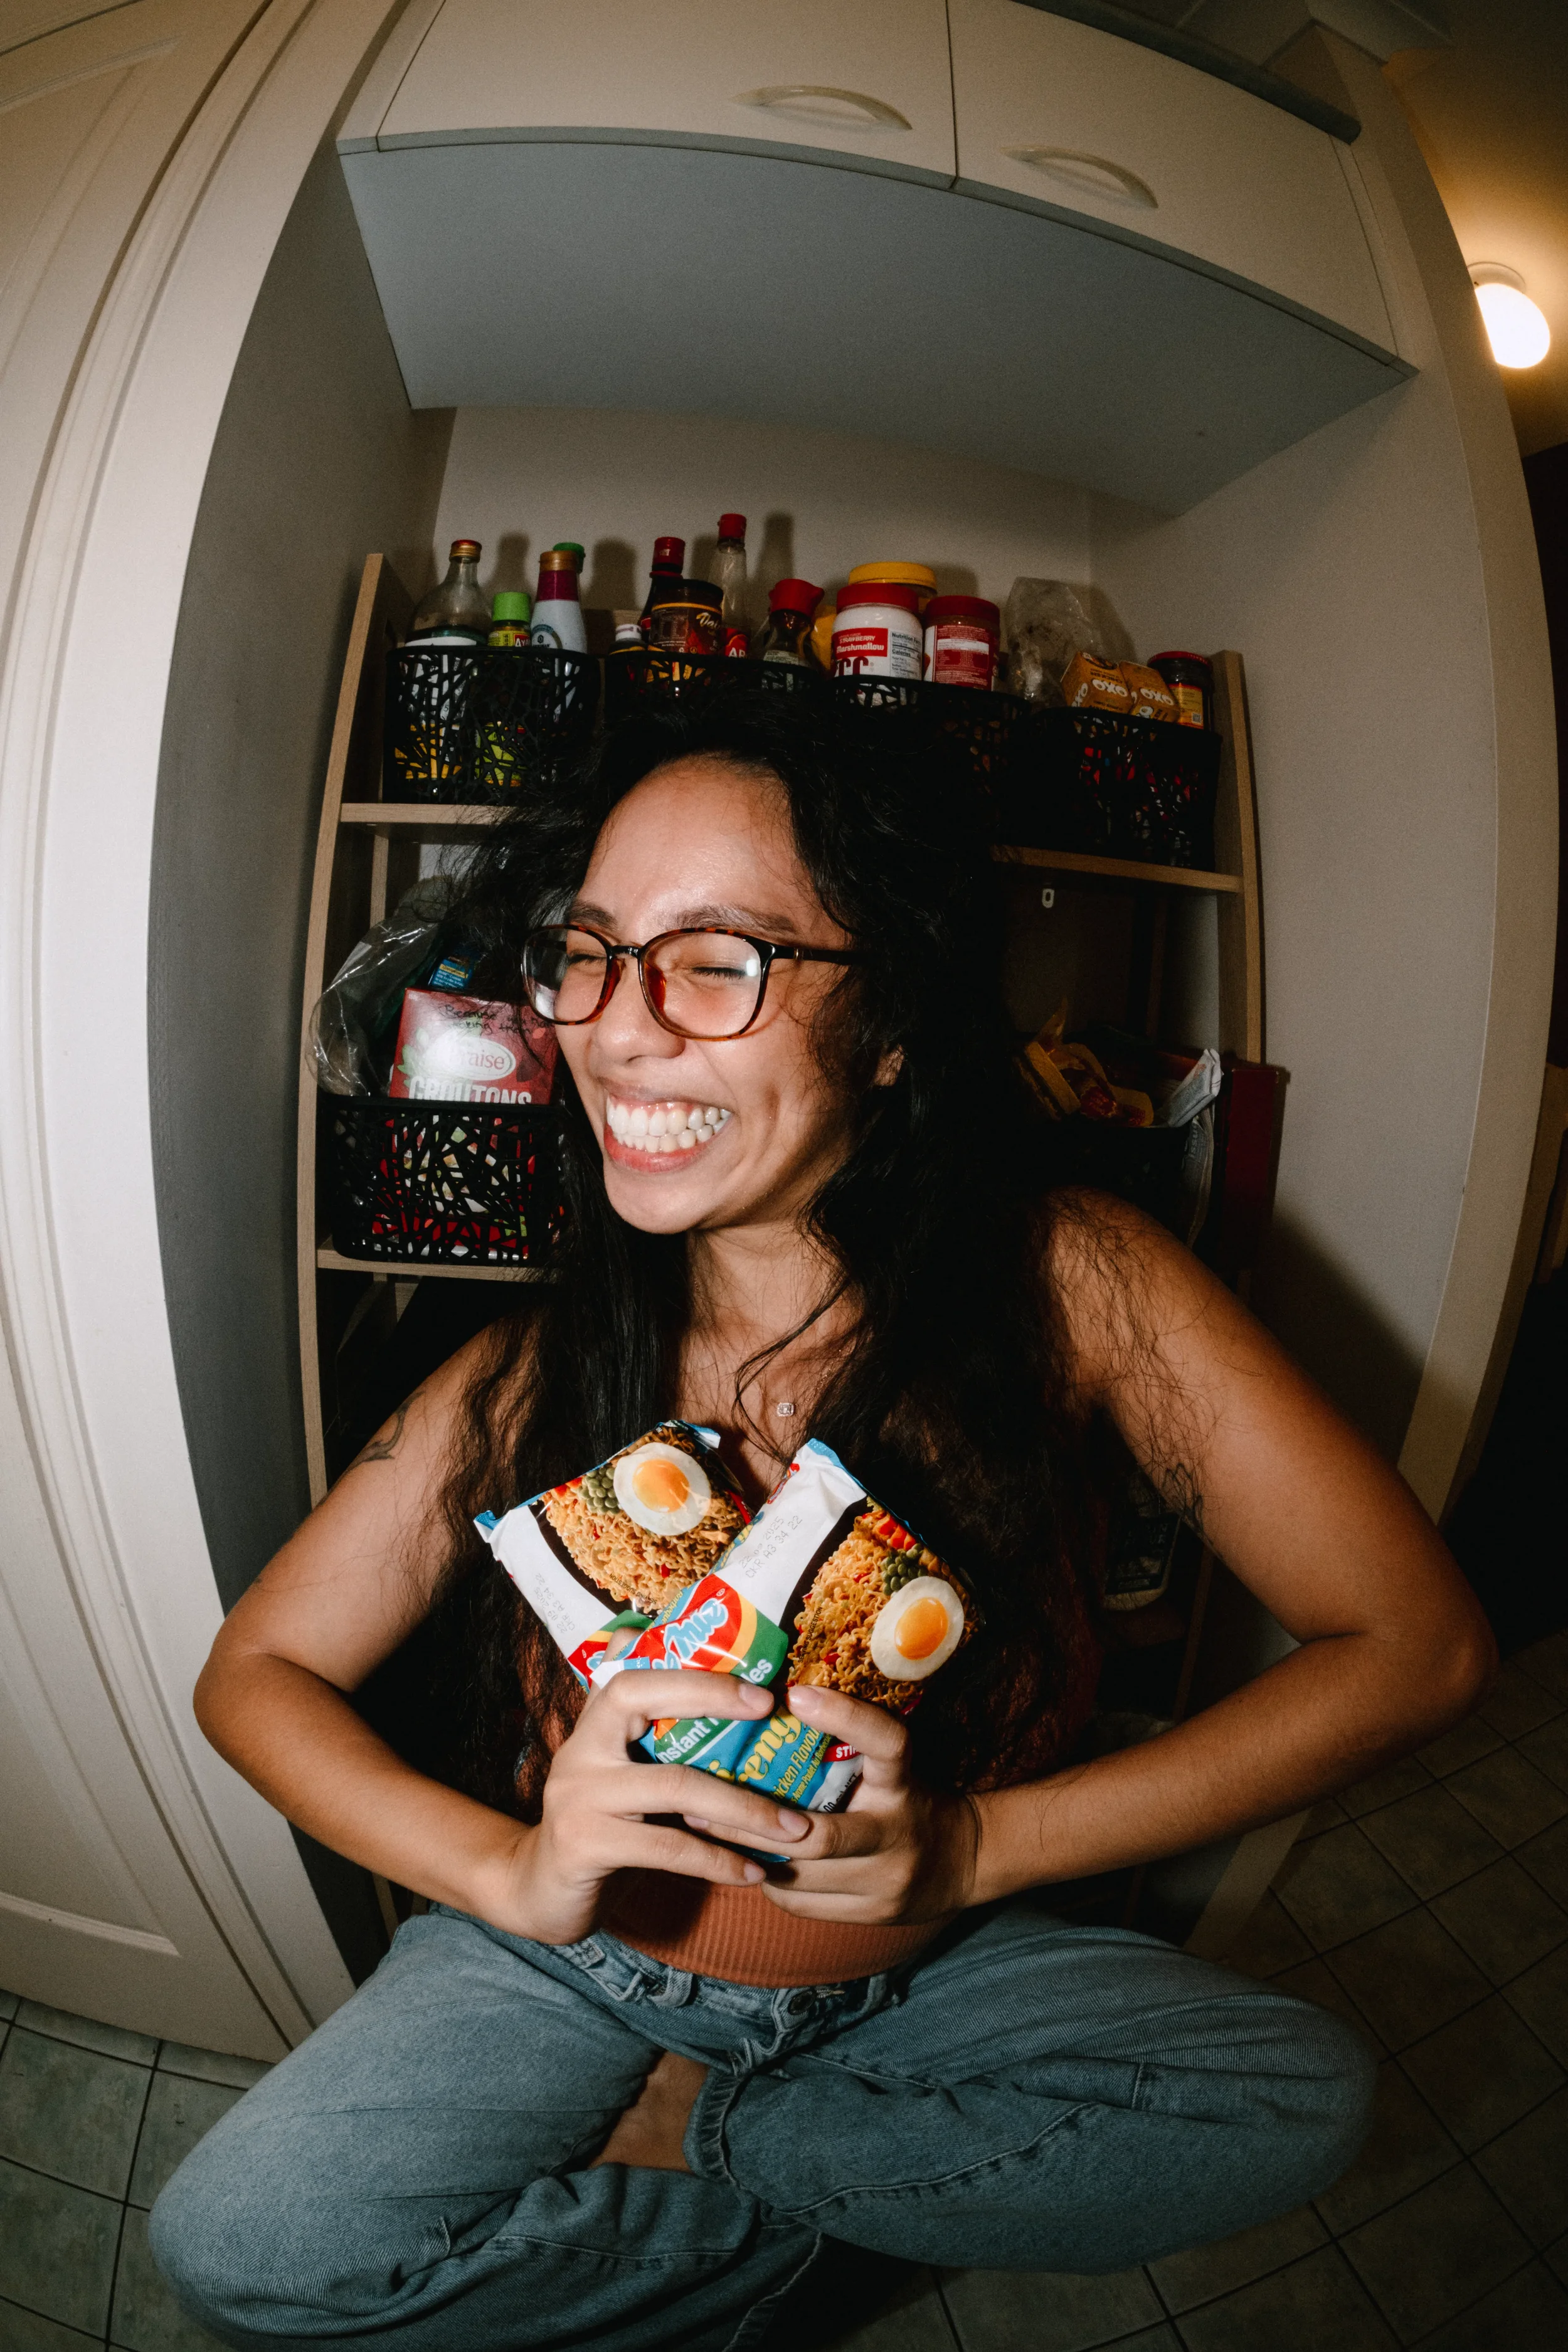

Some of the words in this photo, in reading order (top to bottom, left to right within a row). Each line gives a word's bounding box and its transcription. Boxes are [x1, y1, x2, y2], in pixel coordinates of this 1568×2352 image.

[836, 642, 885, 654] Marshmallow
[839, 635, 876, 644] STRAWBERRY
[1092, 679, 1129, 697] OXO
[1140, 687, 1175, 706] OXO
[409, 1075, 532, 1104] CROUTONS
[763, 1516, 784, 1540] 2025
[745, 1559, 765, 1578] CKR
[763, 1544, 776, 1559] A3
[775, 1530, 789, 1544] 34
[788, 1515, 803, 1530] 22
[535, 1573, 545, 1585] 22
[609, 1573, 636, 1595] SUGGESTION
[635, 1591, 657, 1604] SERVING
[806, 1606, 823, 1641] SUGGESTION
[790, 1726, 821, 1768] Flavou
